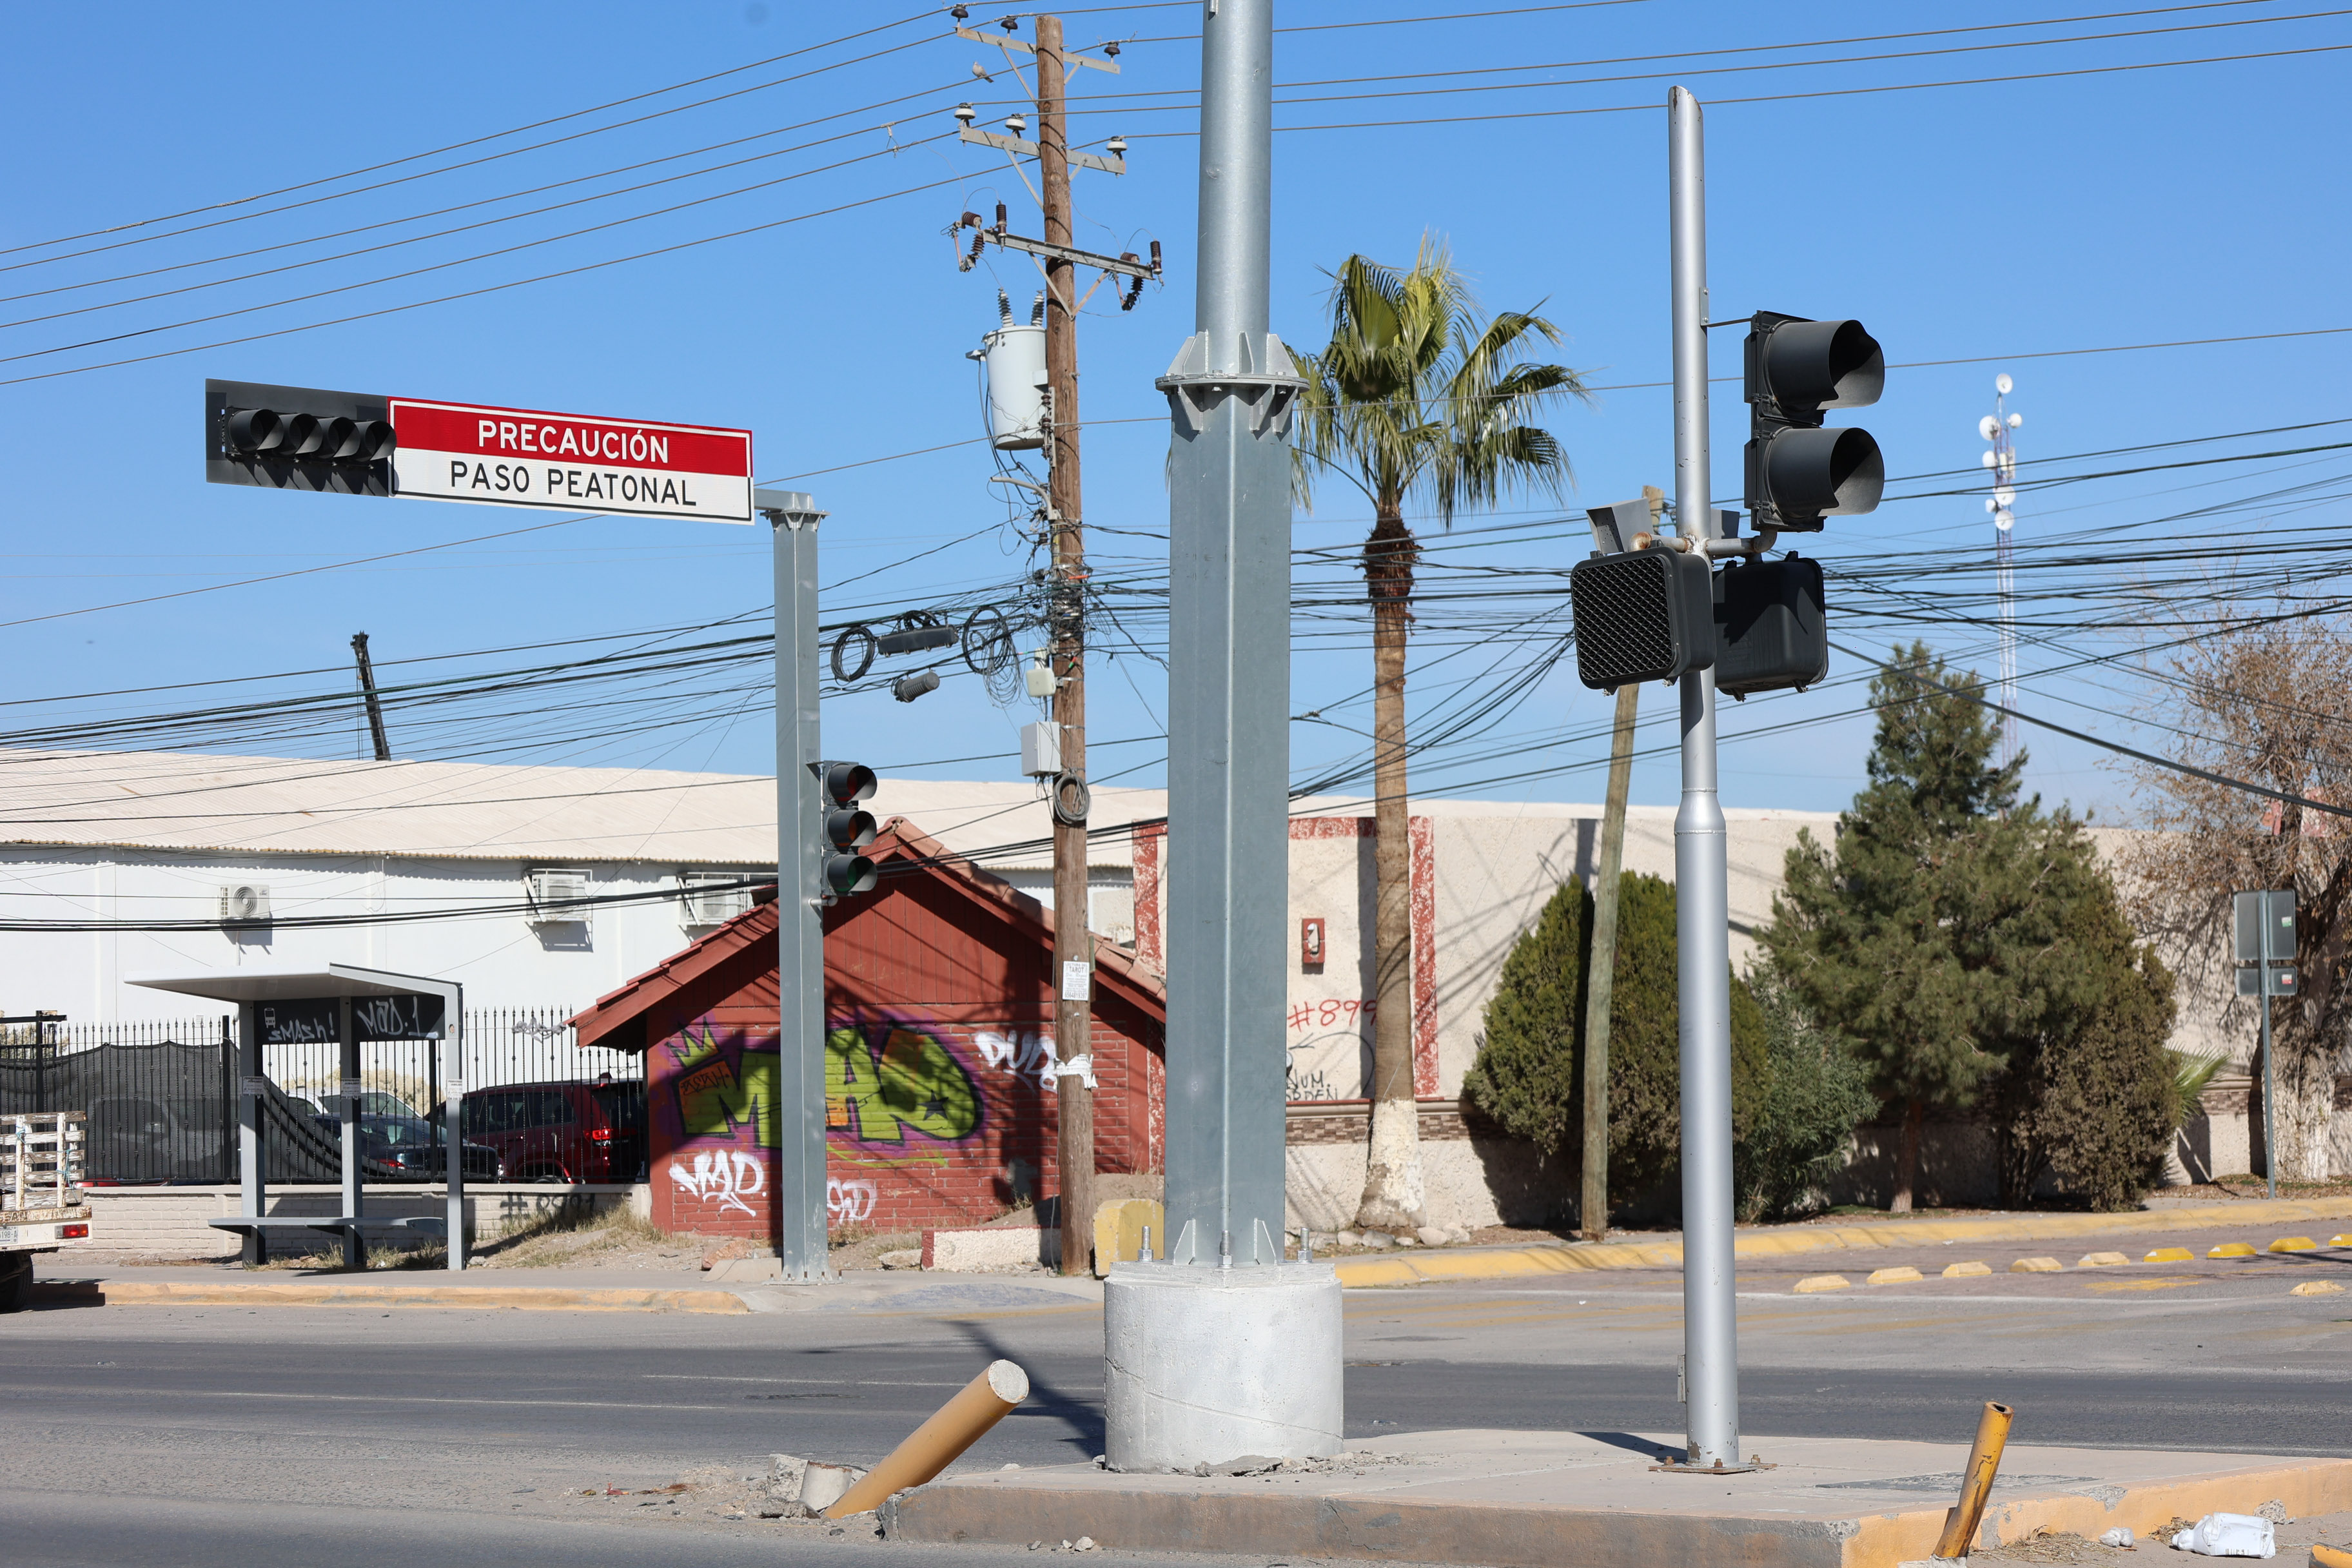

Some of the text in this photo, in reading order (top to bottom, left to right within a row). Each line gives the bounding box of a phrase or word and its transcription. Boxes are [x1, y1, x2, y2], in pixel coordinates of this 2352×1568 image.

[478, 420, 668, 464] PRECAUCIÓN
[451, 460, 697, 507] PASO PEATONAL
[0, 1230, 17, 1239] 198-A
